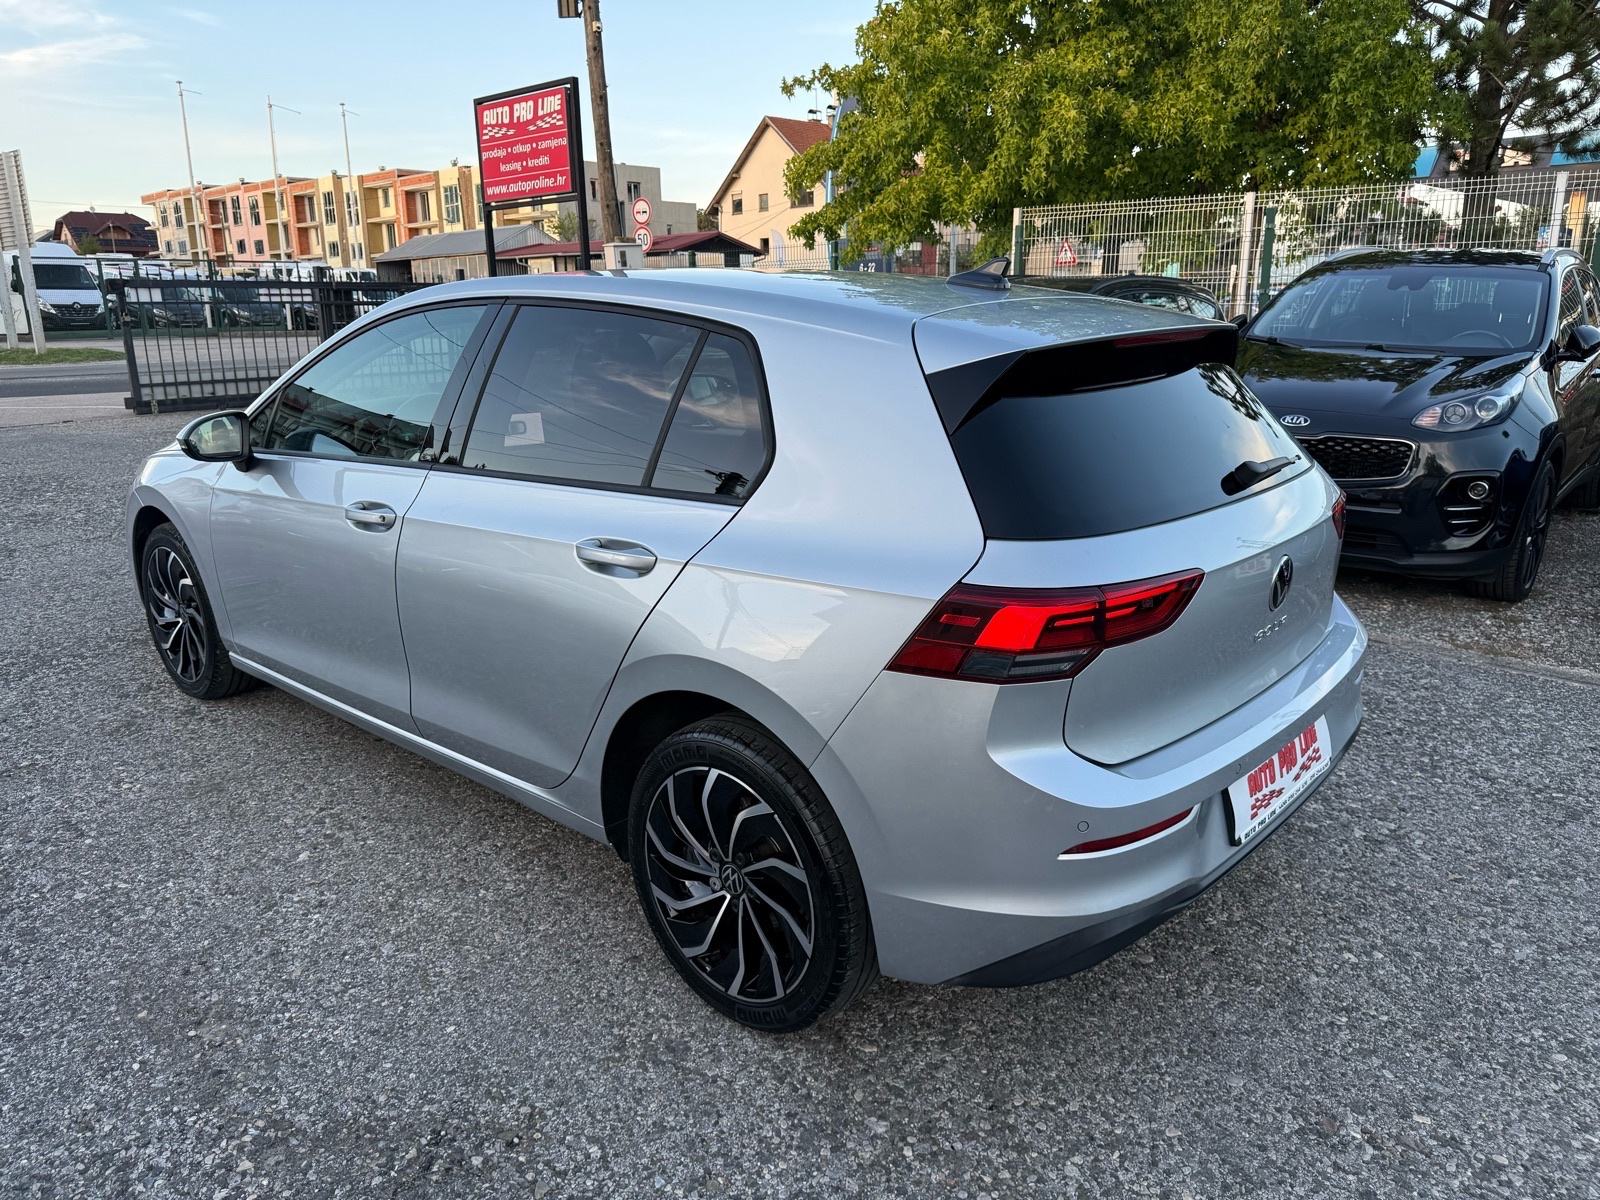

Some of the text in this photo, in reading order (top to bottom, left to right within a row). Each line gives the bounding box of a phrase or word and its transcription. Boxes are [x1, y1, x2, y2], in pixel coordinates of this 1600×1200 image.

[483, 94, 562, 125] AUTO PRO LINE
[482, 136, 567, 161] prodaja otkup zamjena
[499, 155, 550, 172] leasing krediti
[486, 174, 567, 196] www.autoproline.hr
[637, 233, 648, 245] 50
[1284, 415, 1306, 425] KIA
[1247, 756, 1277, 798] AUTO
[1277, 740, 1298, 778] PRO
[1299, 724, 1318, 758] LINE
